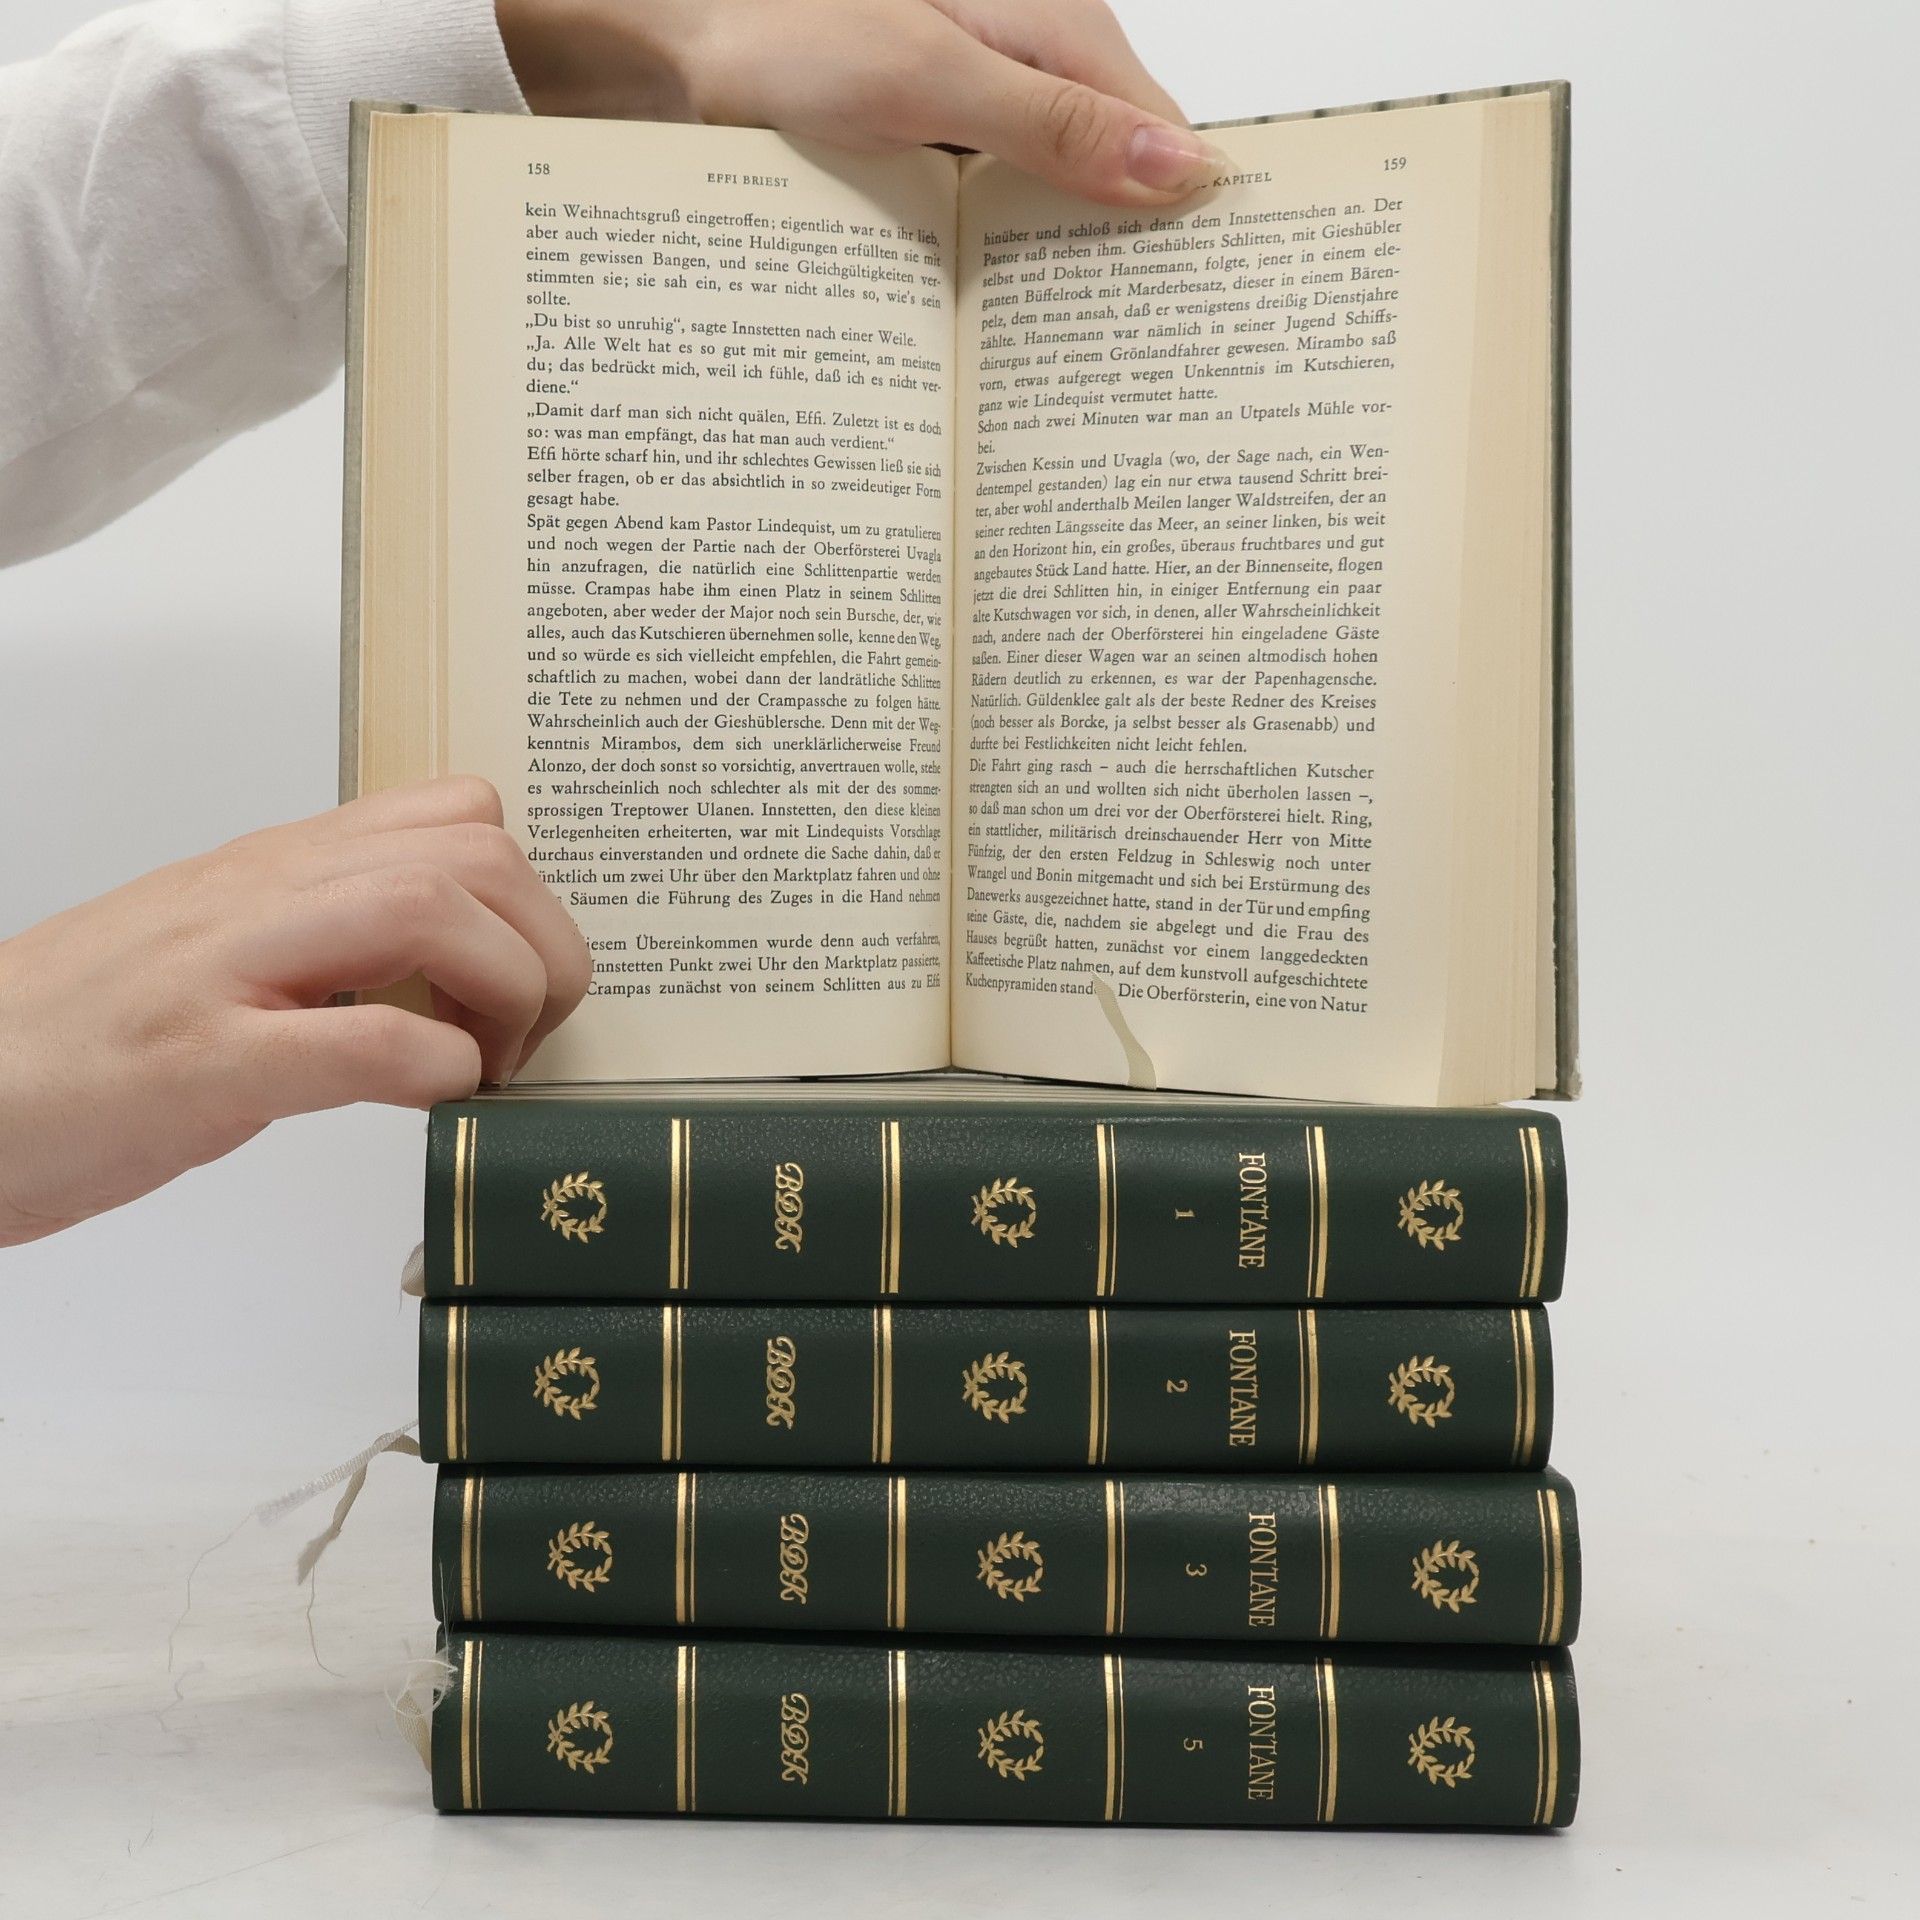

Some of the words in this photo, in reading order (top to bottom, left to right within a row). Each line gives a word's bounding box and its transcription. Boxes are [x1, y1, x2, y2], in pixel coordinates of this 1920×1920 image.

[526, 162, 551, 175] 158
[1383, 156, 1408, 171] 159
[706, 171, 738, 185] EFFI
[743, 174, 790, 188] BRIEST
[1212, 171, 1273, 188] KAPITEL
[525, 201, 557, 218] kein
[562, 203, 681, 226] Weihnachtsgruß
[685, 209, 776, 231] eingetroffen;
[780, 215, 845, 235] eigentlich
[849, 225, 875, 237] war
[879, 227, 893, 239] es
[896, 225, 915, 242] ihr
[917, 228, 941, 249] lieb,
[983, 228, 1030, 247] hinüber
[1035, 224, 1062, 241] und
[1067, 220, 1112, 239] schloß
[1116, 218, 1144, 236] sich
[1146, 216, 1184, 233] dann
[1190, 213, 1222, 230] dem
[1228, 203, 1337, 227] Innstettenschen
[1343, 203, 1366, 216] an.
[1373, 197, 1404, 213] Der
[981, 294, 1019, 313] ganten
[1024, 284, 1093, 304] Büffelrock
[1097, 283, 1122, 299] mit
[1126, 278, 1227, 297] Marderbesatz,
[1232, 275, 1276, 291] dieser
[1280, 272, 1295, 287] in
[1300, 269, 1344, 286] einem
[1349, 266, 1401, 282] Bären-
[524, 312, 558, 329] „Du
[563, 312, 591, 330] bist
[596, 318, 612, 330] so
[690, 322, 727, 337] sagte
[731, 320, 801, 338] Innstetten
[805, 325, 837, 341] nach
[840, 327, 874, 344] einer
[877, 329, 917, 348] Weile.
[526, 401, 584, 418] „Damit
[589, 402, 623, 419] darf
[627, 408, 660, 420] man
[665, 405, 693, 421] sich
[697, 406, 734, 423] nicht
[738, 408, 790, 427] quälen,
[795, 409, 827, 426] Effi.
[832, 411, 880, 429] Zuletzt
[884, 415, 899, 431] ist
[903, 421, 915, 433] es
[918, 418, 943, 436] doch
[975, 458, 1027, 477] Zwischen
[1032, 455, 1075, 472] Kessin
[1080, 453, 1107, 469] und
[1113, 451, 1163, 470] Uvagla
[1169, 449, 1200, 468] (wo,
[1206, 449, 1232, 465] der
[1236, 448, 1271, 467] Sage
[1275, 445, 1314, 464] nach,
[1319, 445, 1342, 461] ein
[1349, 443, 1390, 459] Wen-
[526, 512, 561, 532] Spät
[565, 517, 609, 533] gegen
[613, 514, 664, 531] Abend
[669, 515, 701, 531] kam
[706, 516, 753, 533] Pastor
[757, 517, 836, 537] Lindequist,
[839, 524, 862, 536] um
[865, 525, 881, 537] zu
[884, 524, 942, 542] gratulieren
[972, 588, 995, 606] jetzt
[998, 586, 1018, 601] die
[1022, 584, 1048, 600] drei
[1053, 583, 1110, 599] Schlitten
[1116, 582, 1143, 600] hin,
[1149, 582, 1164, 597] in
[1170, 581, 1220, 601] einiger
[1226, 580, 1311, 599] Entfernung
[1316, 579, 1340, 595] ein
[1347, 583, 1383, 598] paar
[527, 646, 557, 662] und
[561, 650, 578, 662] so
[583, 646, 631, 663] würde
[635, 651, 651, 663] es
[655, 647, 684, 663] sich
[687, 647, 756, 664] vielleicht
[759, 648, 837, 667] empfehlen,
[840, 649, 863, 665] die
[866, 650, 902, 667] Fahrt
[904, 653, 942, 670] gemein-
[970, 671, 1007, 687] Rädern
[1012, 670, 1062, 686] deutlich
[1067, 674, 1084, 685] zu
[1090, 669, 1157, 688] erkennen,
[1164, 674, 1178, 686] es
[1186, 674, 1215, 686] war
[1221, 669, 1247, 686] der
[1253, 670, 1378, 690] Papenhagensche.
[526, 712, 641, 729] Wahrscheinlich
[645, 713, 679, 729] auch
[683, 713, 709, 729] der
[713, 713, 826, 730] Gieshüblersche.
[830, 714, 868, 730] Denn
[871, 715, 894, 731] mit
[896, 715, 917, 731] der
[918, 716, 942, 736] Weg-
[967, 842, 1006, 862] Fünfzig,
[1011, 844, 1033, 860] der
[1038, 844, 1062, 861] den
[1069, 849, 1109, 862] ersten
[1117, 847, 1174, 869] Feldzug
[1181, 849, 1196, 866] in
[1204, 850, 1276, 873] Schleswig
[1285, 854, 1320, 871] noch
[1330, 859, 1372, 873] unter
[569, 890, 629, 907] Säumen
[636, 889, 660, 906] die
[667, 889, 731, 909] Führung
[737, 889, 763, 905] des
[770, 889, 814, 908] Zuges
[820, 888, 835, 904] in
[841, 888, 864, 904] die
[869, 888, 904, 904] Hand
[908, 888, 942, 904] nehmen
[965, 928, 998, 946] Hauses
[1003, 931, 1049, 951] begrüßt
[1054, 933, 1098, 954] hatten,
[1105, 938, 1165, 955] zunächst
[1172, 945, 1198, 957] vor
[1206, 942, 1251, 960] einem
[1260, 945, 1369, 967] langgedeckten
[669, 956, 714, 973] Punkt
[718, 956, 753, 972] zwei
[757, 955, 788, 972] Uhr
[792, 955, 820, 971] den
[824, 953, 898, 973] Marktplatz
[1174, 1208, 1196, 1220] 1
[1238, 1152, 1270, 1268] FONTANE
[1166, 1379, 1189, 1394] 2
[1228, 1329, 1260, 1446] FONTANE
[1185, 1563, 1208, 1577] 3
[1248, 1512, 1280, 1627] FONTANE
[1183, 1737, 1204, 1752] 5
[1247, 1685, 1279, 1800] FONTANE
